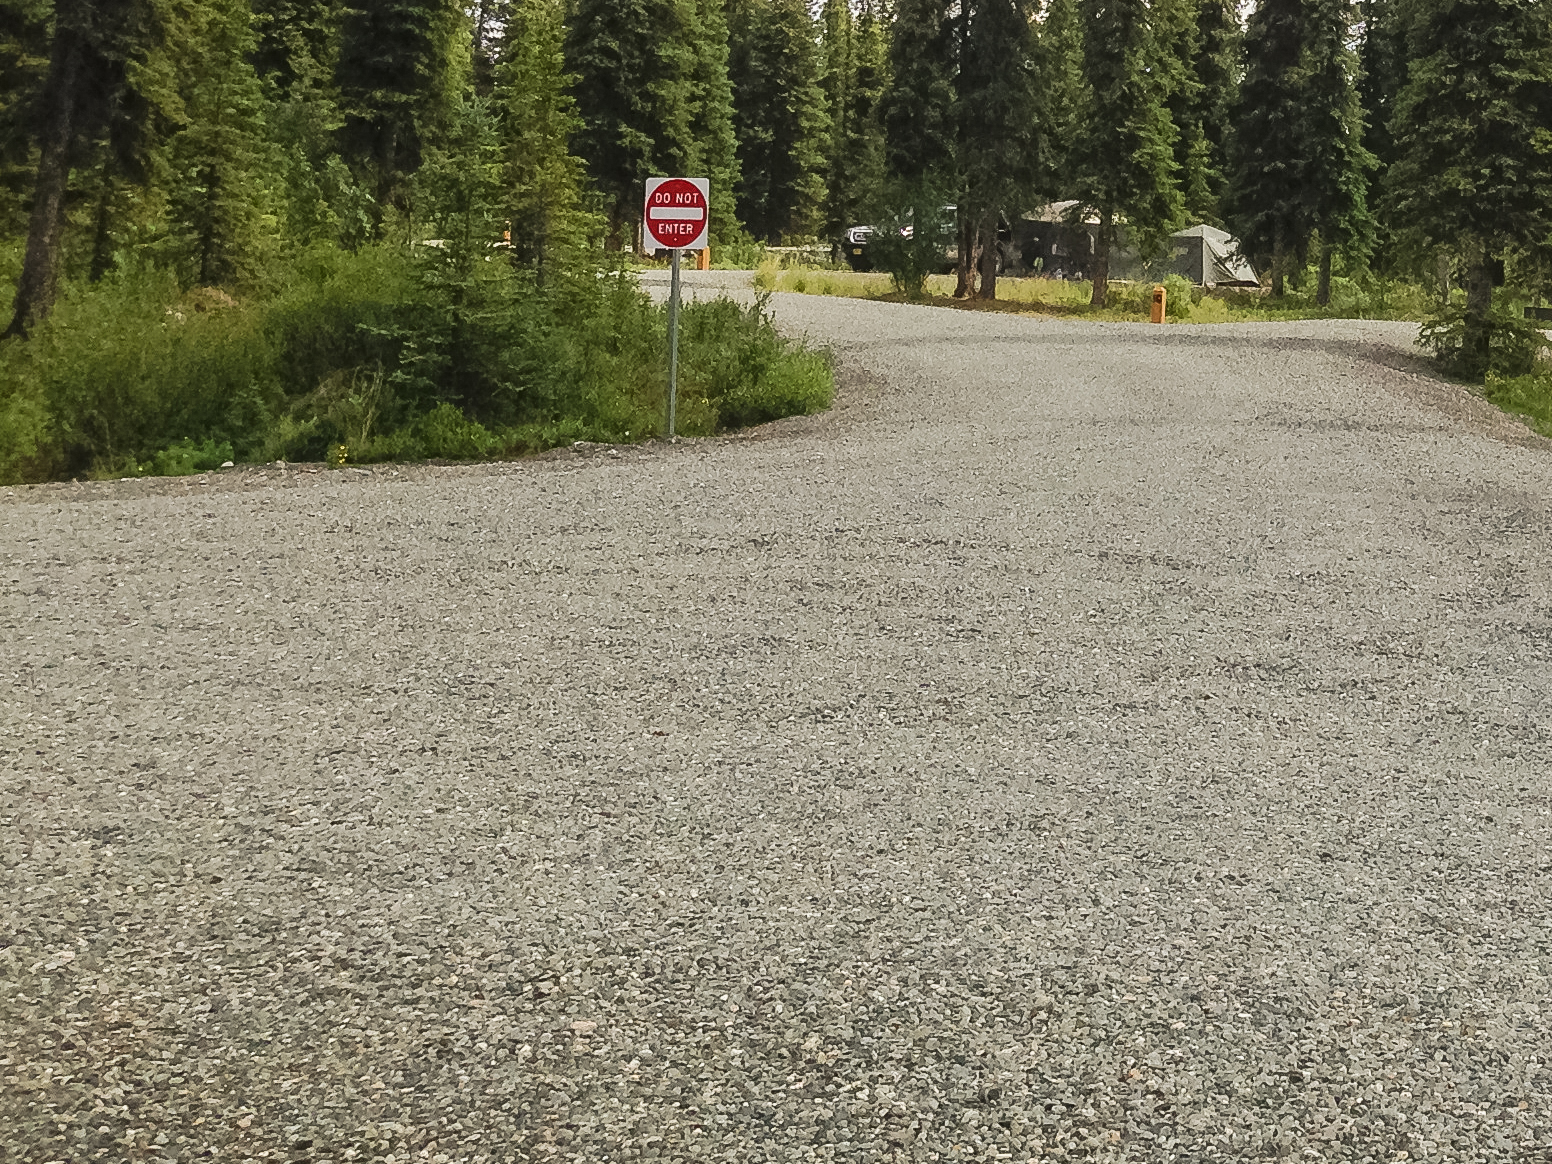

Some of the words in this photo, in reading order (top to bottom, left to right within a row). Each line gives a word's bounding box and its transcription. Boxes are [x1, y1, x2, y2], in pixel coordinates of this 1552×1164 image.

[655, 192, 671, 204] DO
[675, 192, 699, 204] NOT
[658, 223, 694, 235] ENTER
